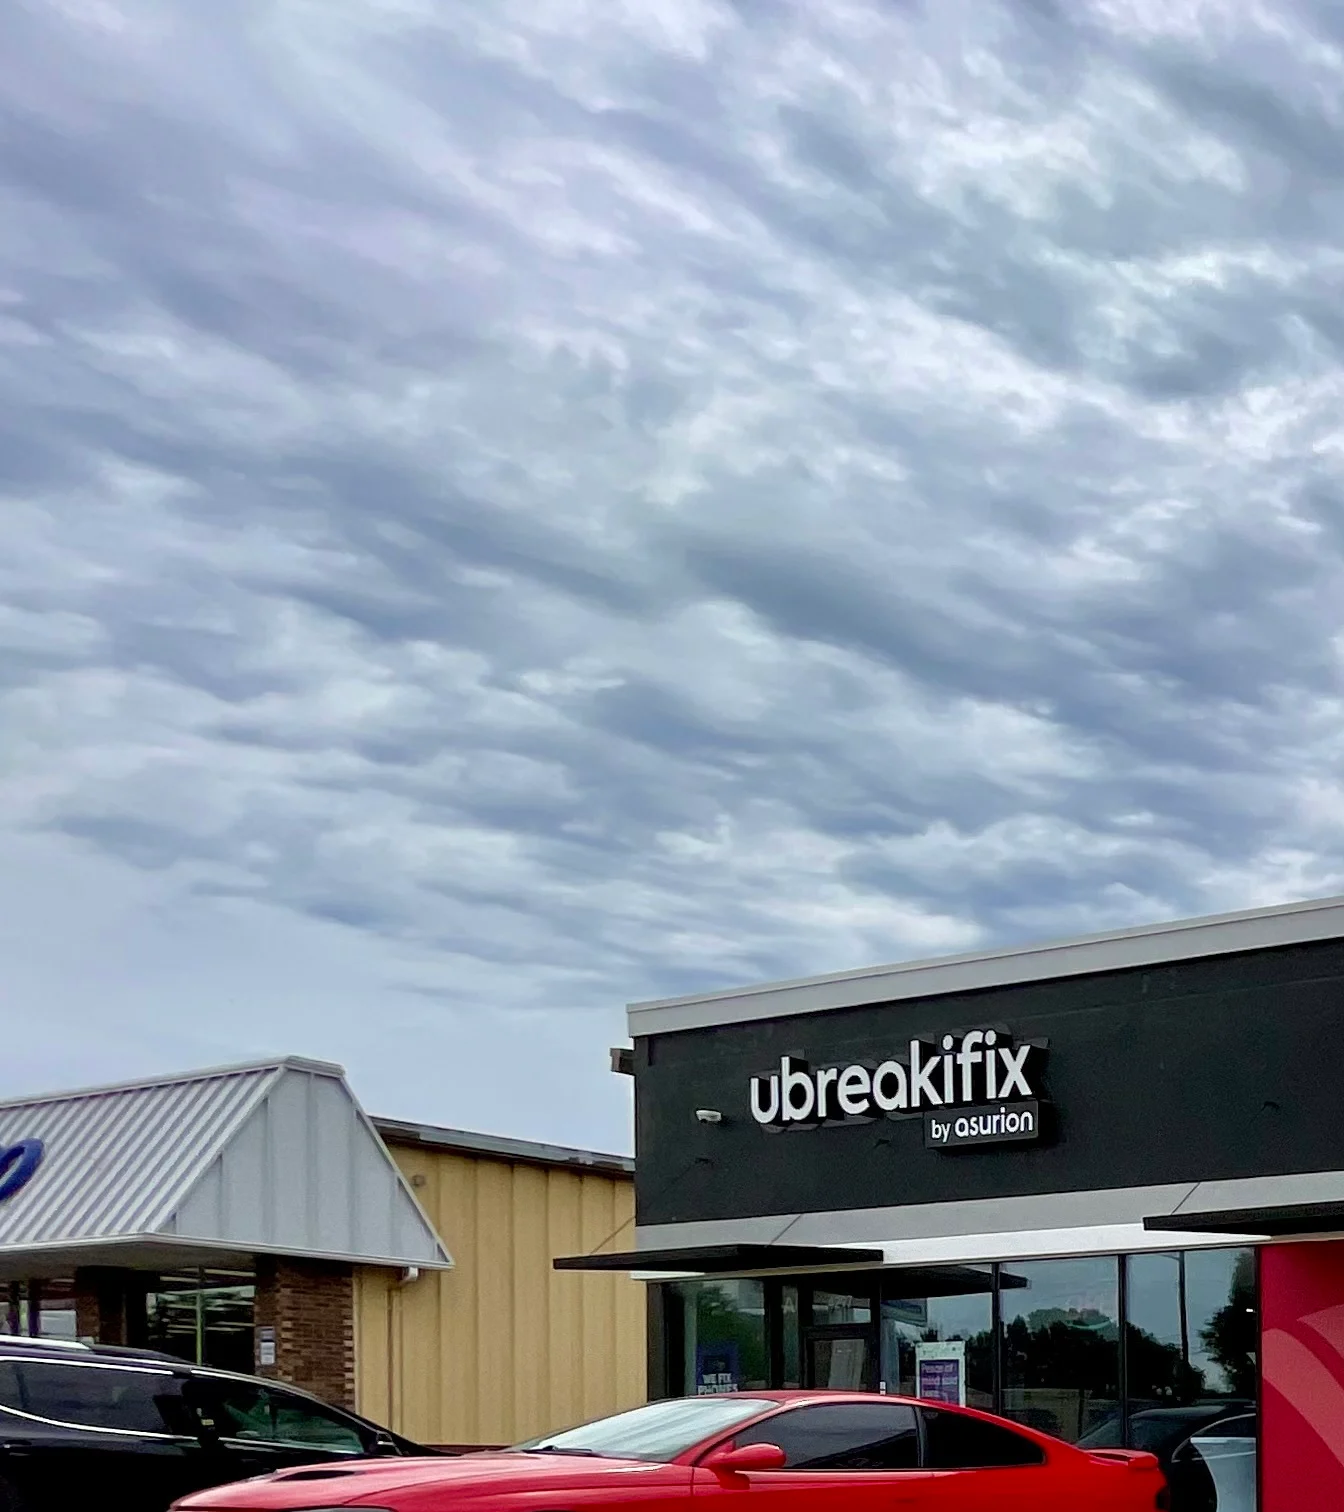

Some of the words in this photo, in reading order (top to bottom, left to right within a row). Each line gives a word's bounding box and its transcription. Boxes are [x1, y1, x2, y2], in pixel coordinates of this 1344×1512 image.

[750, 1029, 1033, 1124] ubreakifix
[931, 1119, 951, 1143] by
[954, 1107, 1033, 1138] asurion
